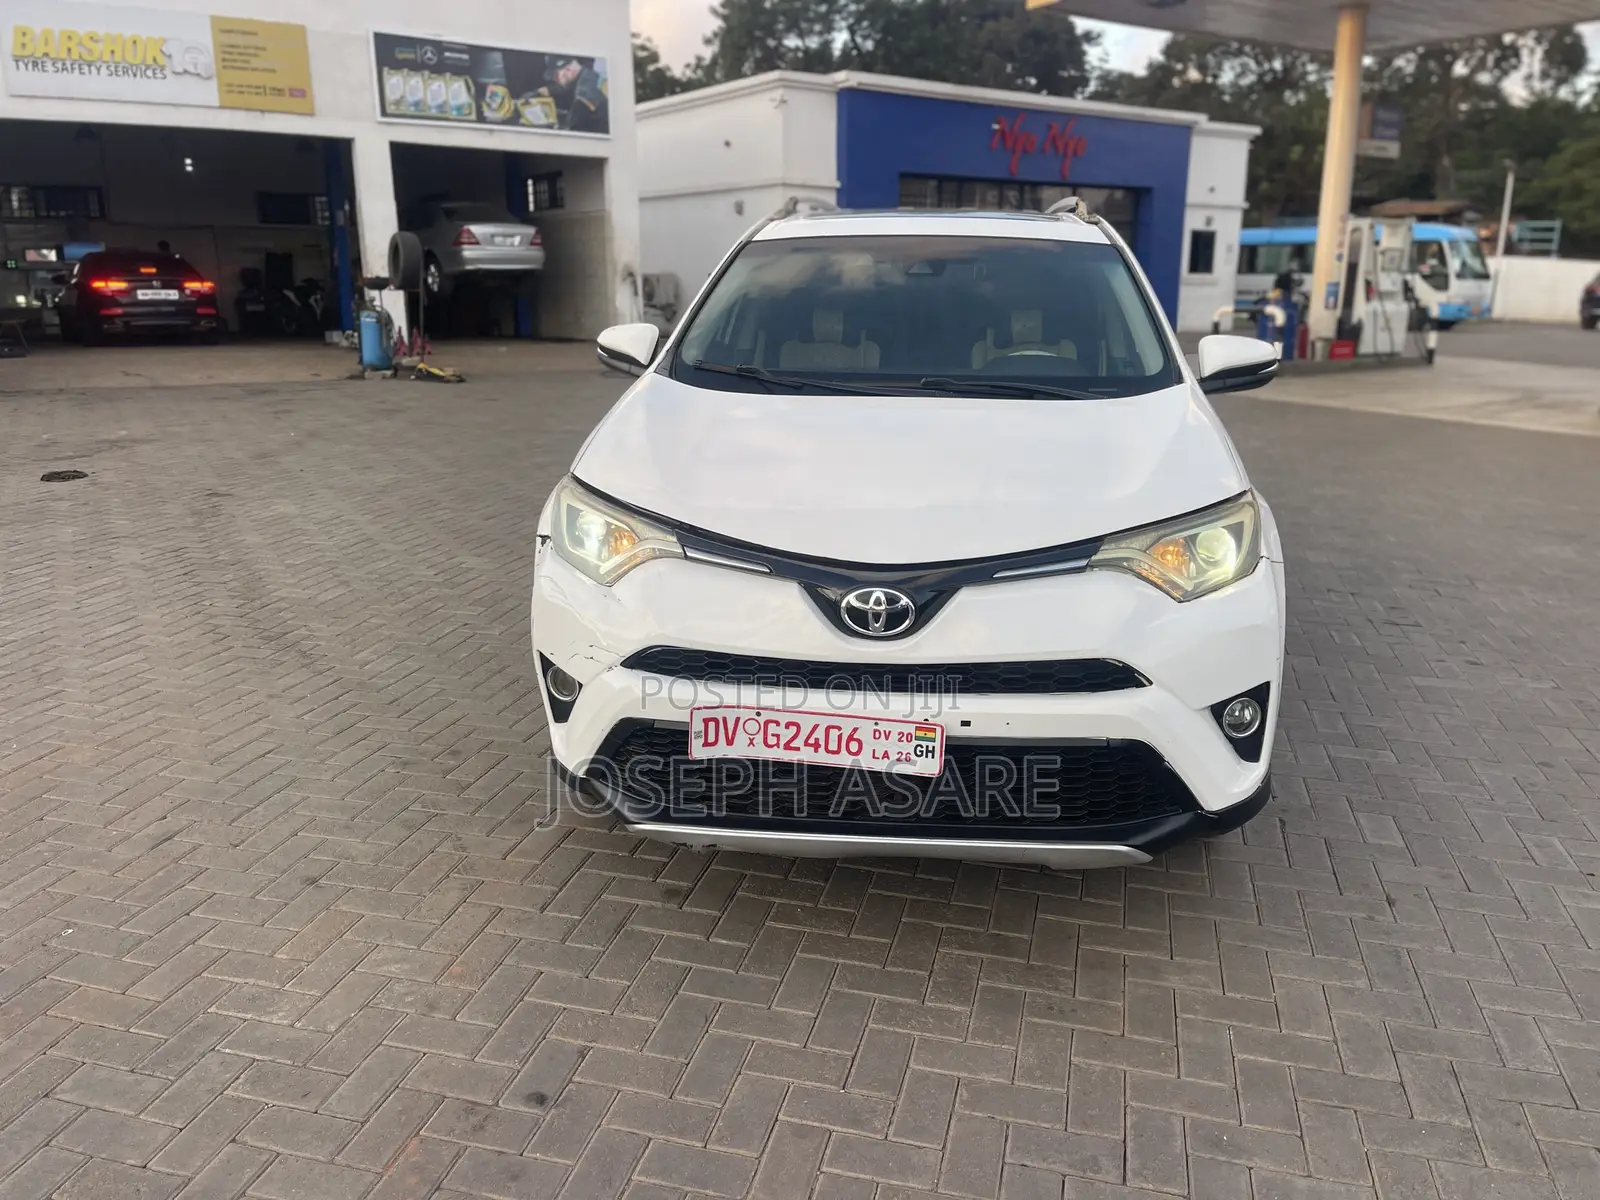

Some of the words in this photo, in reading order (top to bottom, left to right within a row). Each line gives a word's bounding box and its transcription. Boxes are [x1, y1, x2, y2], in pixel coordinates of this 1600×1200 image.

[12, 25, 166, 66] BARSHOK
[14, 59, 50, 73] TYRE
[52, 61, 102, 76] SAFETY
[105, 64, 168, 80] SERVICES
[702, 716, 741, 748] DV
[762, 719, 864, 757] G2406
[873, 728, 892, 741] DV
[897, 731, 914, 743] 20
[872, 749, 890, 760] LA
[914, 744, 936, 759] GH
